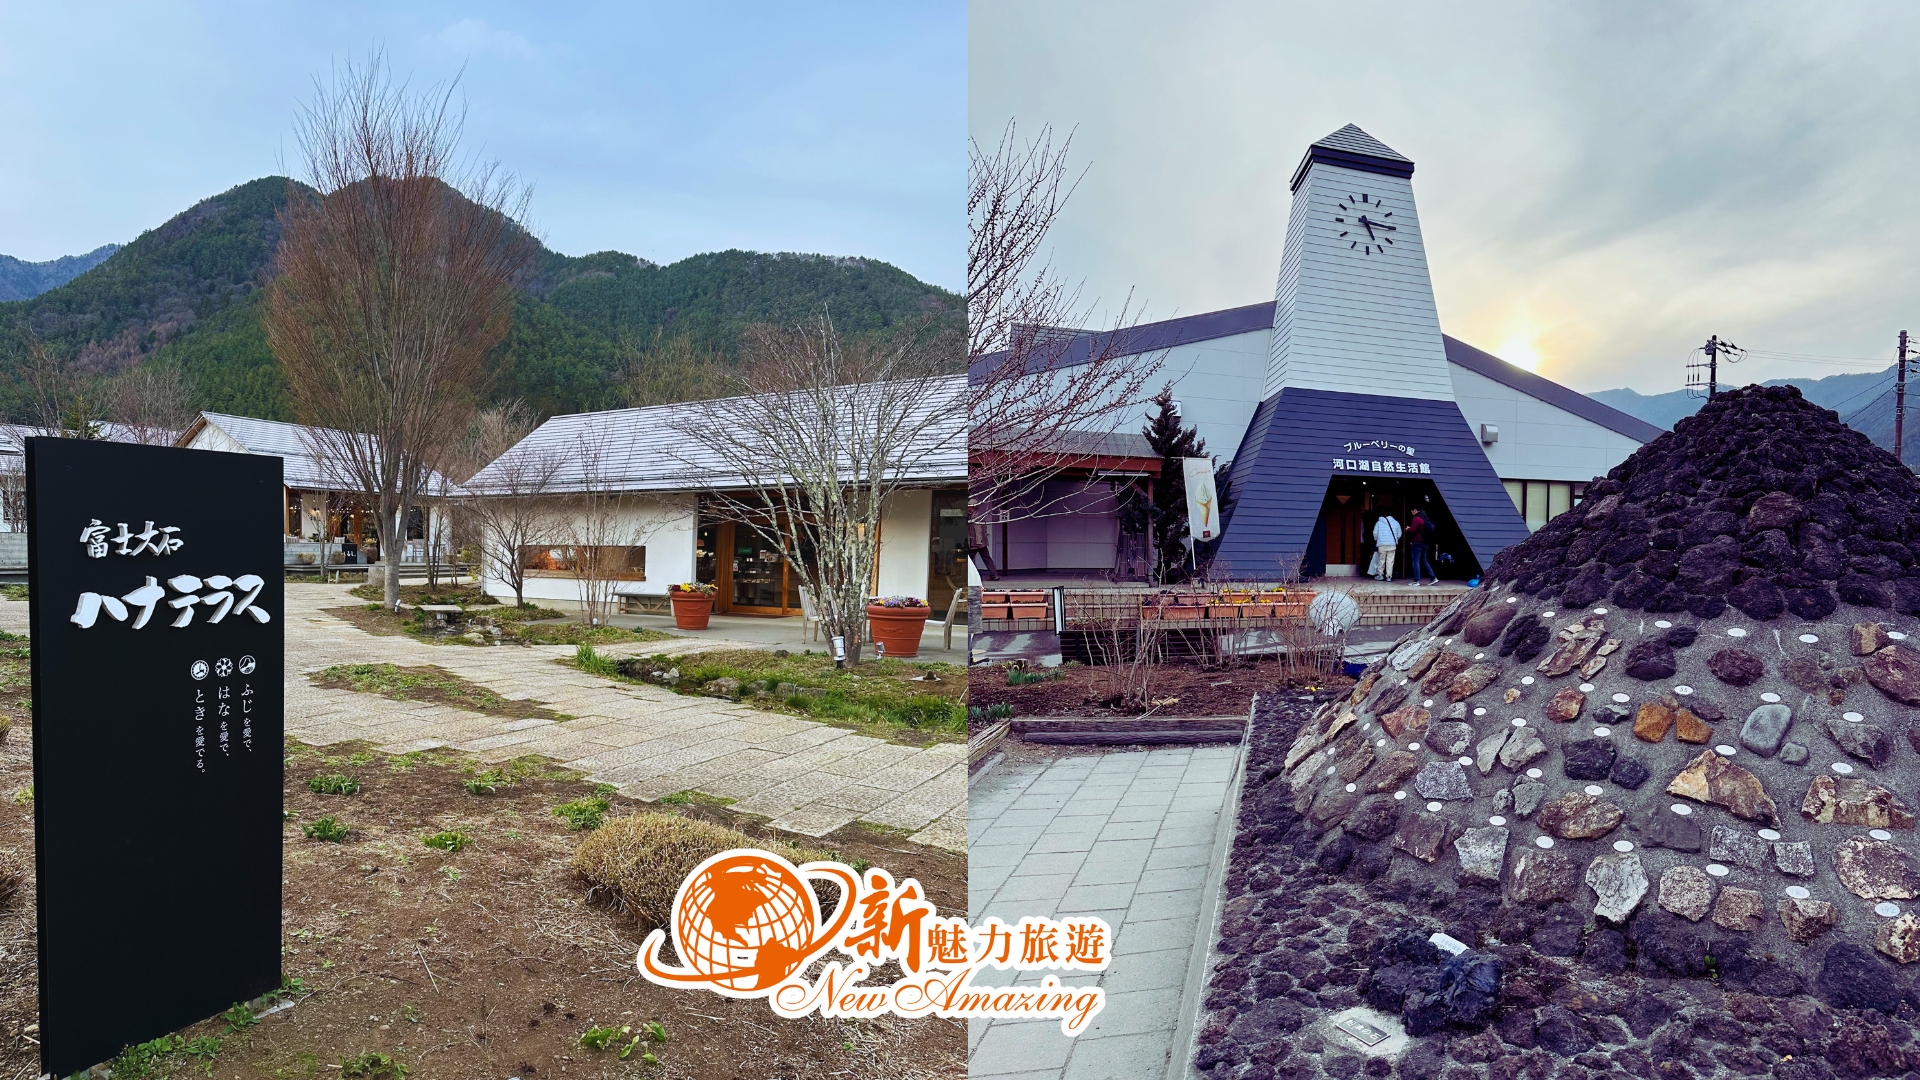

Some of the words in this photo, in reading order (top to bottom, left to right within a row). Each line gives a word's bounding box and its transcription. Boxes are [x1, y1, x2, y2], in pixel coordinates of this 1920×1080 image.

[1332, 458, 1431, 474] 河口湖自然生活館
[79, 518, 186, 559] 富士大石
[70, 573, 271, 630] ハナテラス
[194, 689, 207, 774] ときを愛でる。
[1880, 905, 1896, 914] 192
